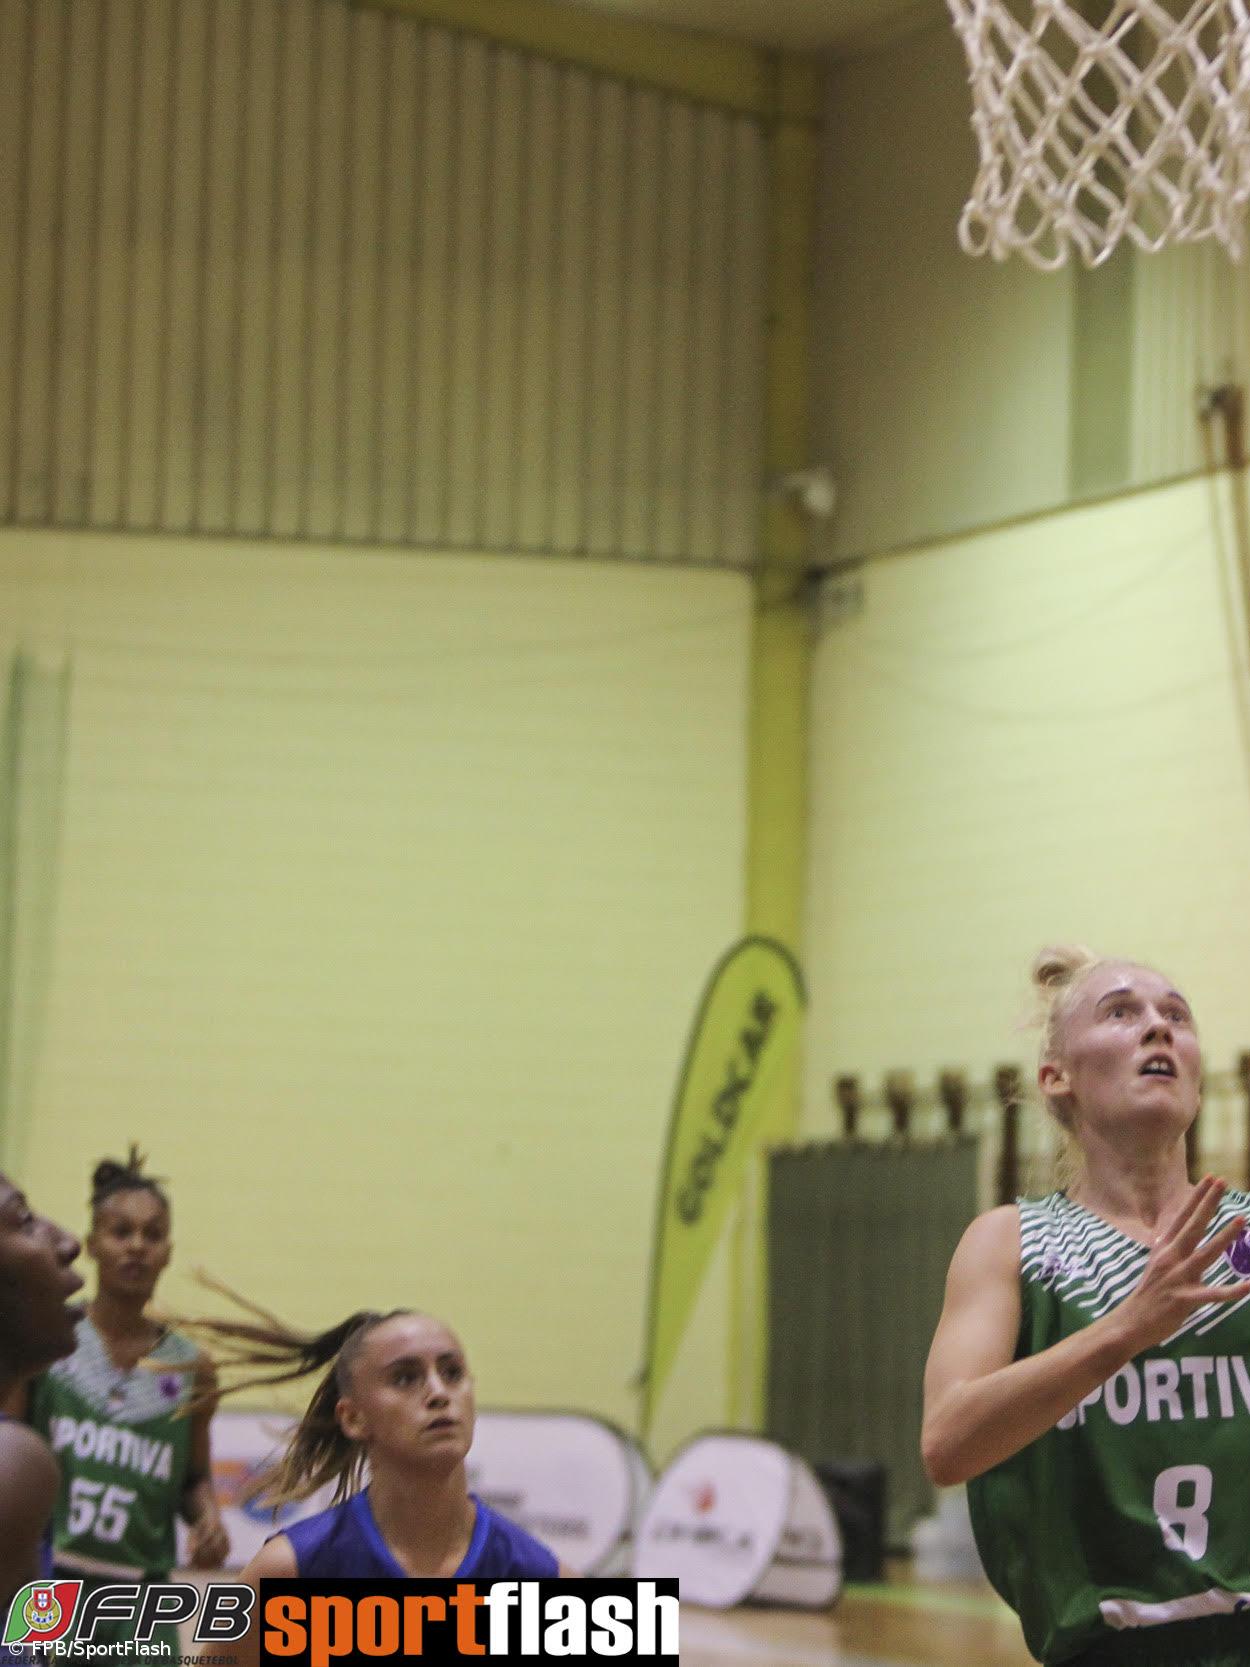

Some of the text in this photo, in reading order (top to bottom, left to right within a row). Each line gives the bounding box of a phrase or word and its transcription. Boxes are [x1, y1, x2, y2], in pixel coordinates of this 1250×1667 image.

[677, 990, 777, 1227] GOLDCAR
[67, 1476, 138, 1544] 55
[1153, 1464, 1213, 1560] 8
